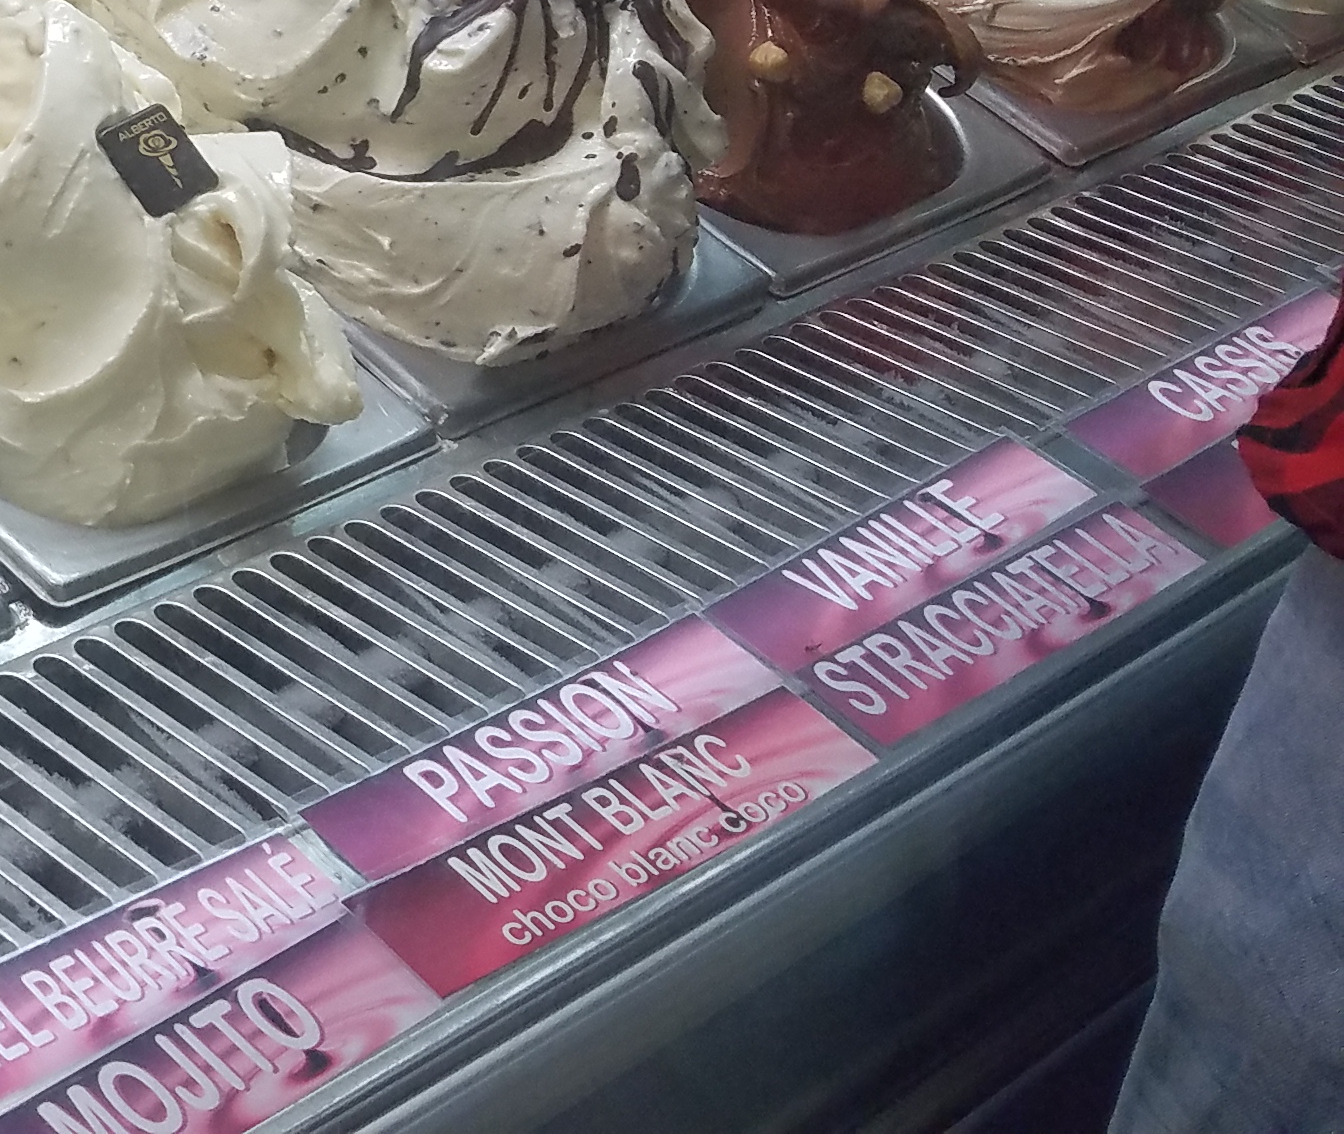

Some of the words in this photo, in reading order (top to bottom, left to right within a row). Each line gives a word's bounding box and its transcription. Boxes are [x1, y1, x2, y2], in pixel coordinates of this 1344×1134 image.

[118, 111, 168, 143] ALBERTO
[782, 478, 1005, 611] VANILLE
[813, 513, 1179, 715] STRACCIATELLA
[403, 660, 679, 823] PASSION
[447, 802, 604, 904] MONT
[581, 734, 752, 835] BLANC
[21, 902, 230, 1030] BEURRE
[197, 843, 338, 943] SALÉ
[502, 878, 620, 946] choco
[610, 825, 719, 888] blanc
[719, 780, 807, 834] coco
